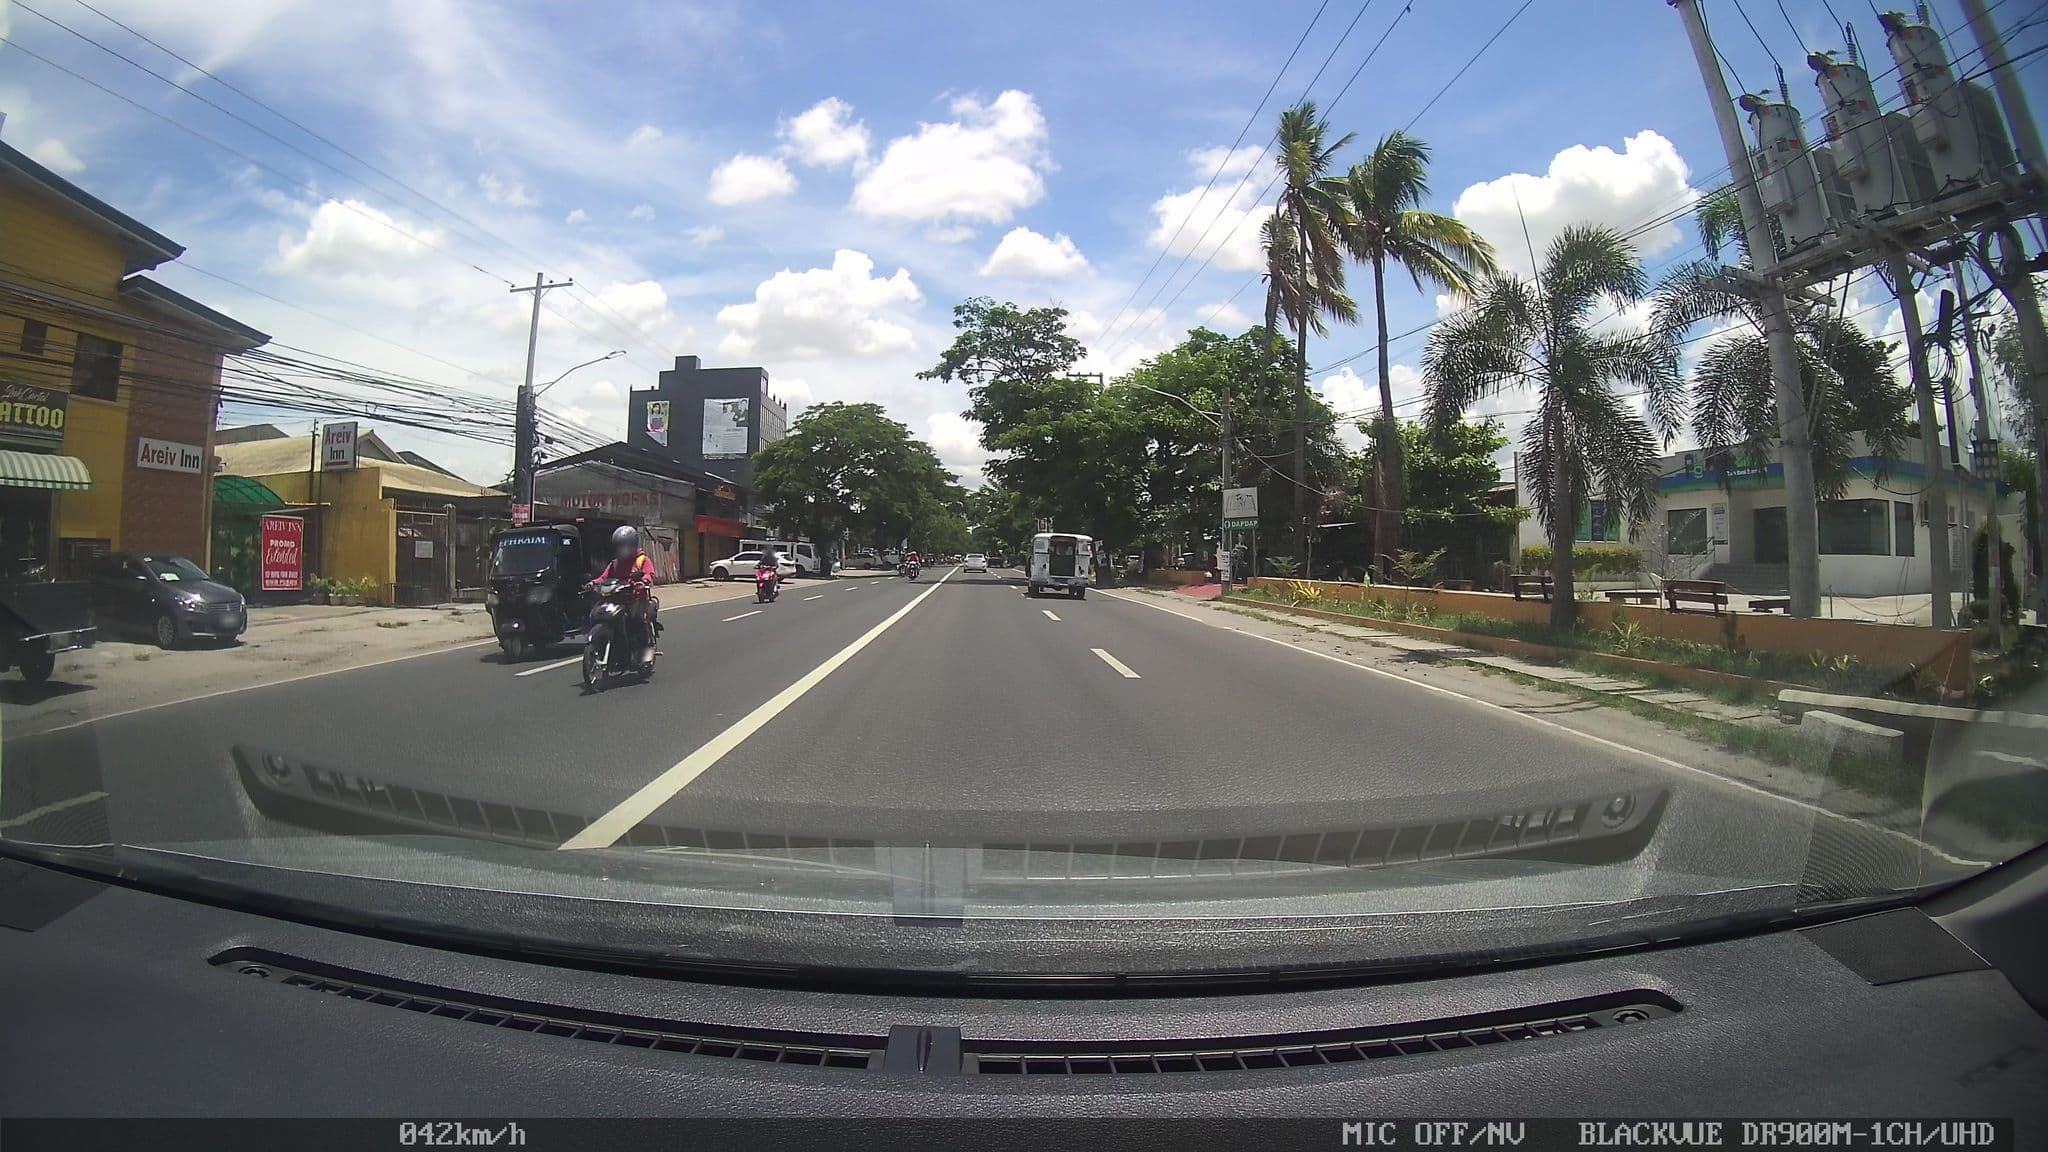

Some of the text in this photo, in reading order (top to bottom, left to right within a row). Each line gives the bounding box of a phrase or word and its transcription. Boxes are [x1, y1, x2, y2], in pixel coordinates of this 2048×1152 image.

[325, 427, 351, 445] Areiv
[140, 443, 200, 469] Areiv Inn
[330, 446, 345, 461] Inn
[1231, 520, 1258, 529] DAPDAP
[269, 539, 296, 548] PROMO
